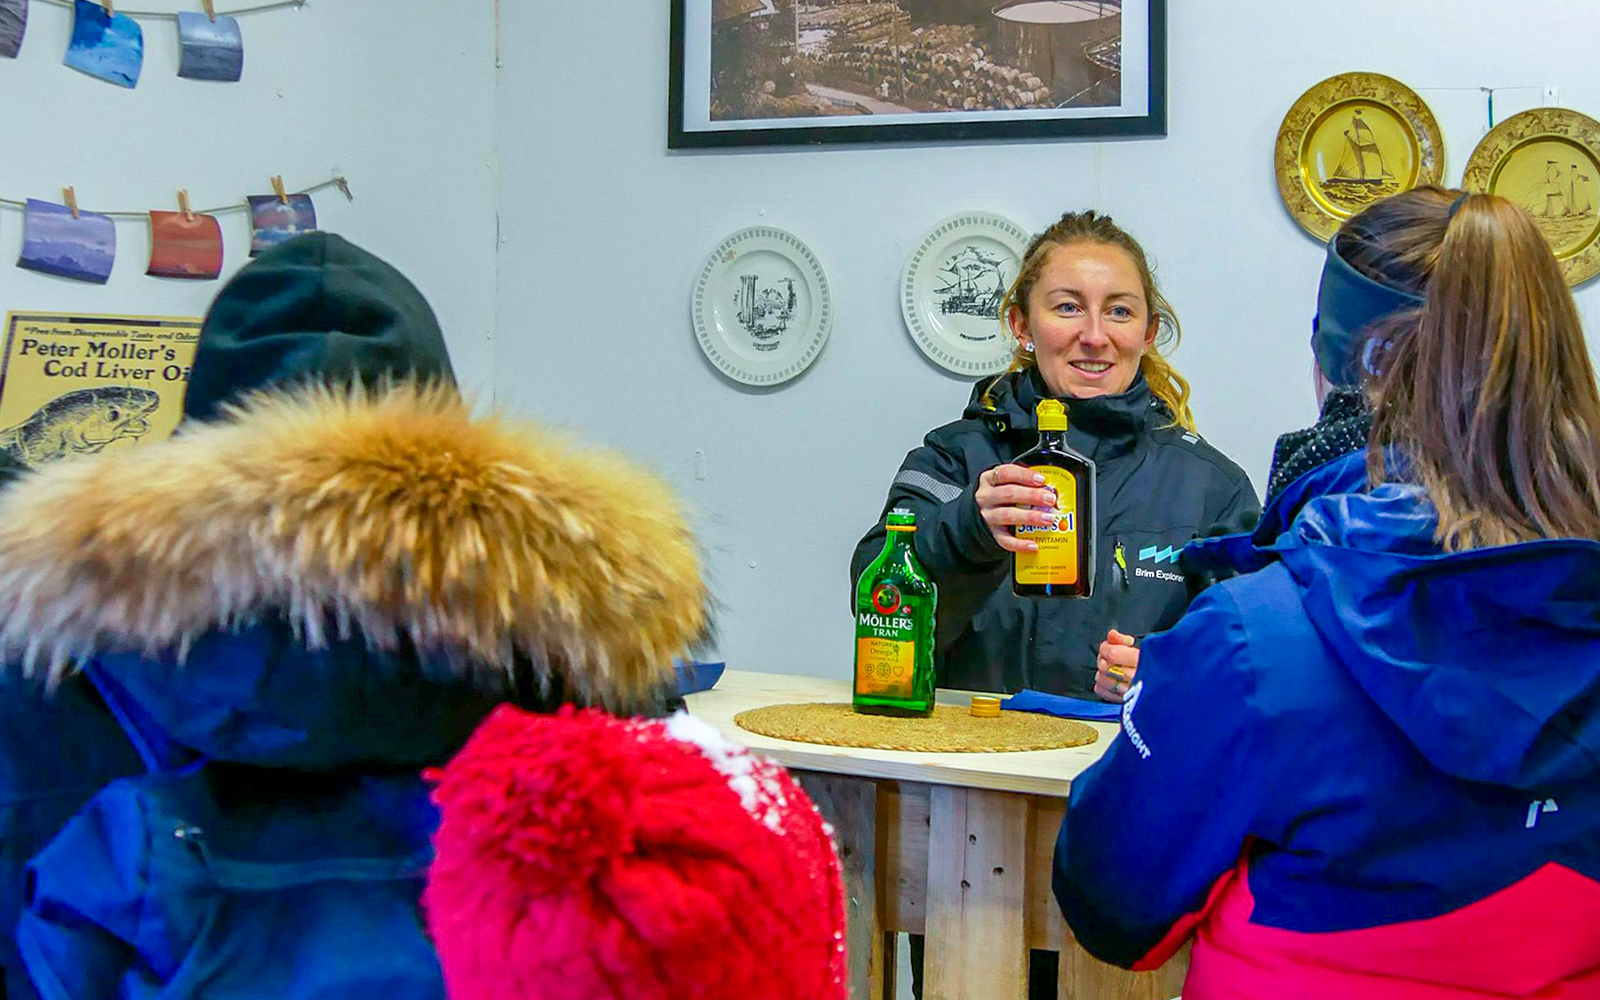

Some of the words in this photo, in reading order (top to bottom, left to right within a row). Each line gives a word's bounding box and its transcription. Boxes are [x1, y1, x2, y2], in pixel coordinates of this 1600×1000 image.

[131, 330, 154, 338] Taste
[19, 339, 80, 357] Peter
[85, 341, 176, 361] Moller's
[43, 359, 88, 378] Cod
[95, 362, 156, 380] Liver
[162, 365, 192, 381] Oi
[1135, 567, 1155, 578] Brim
[1156, 569, 1185, 583] Explorer
[859, 612, 914, 631] MÖLLER'S
[873, 628, 899, 637] TRAN
